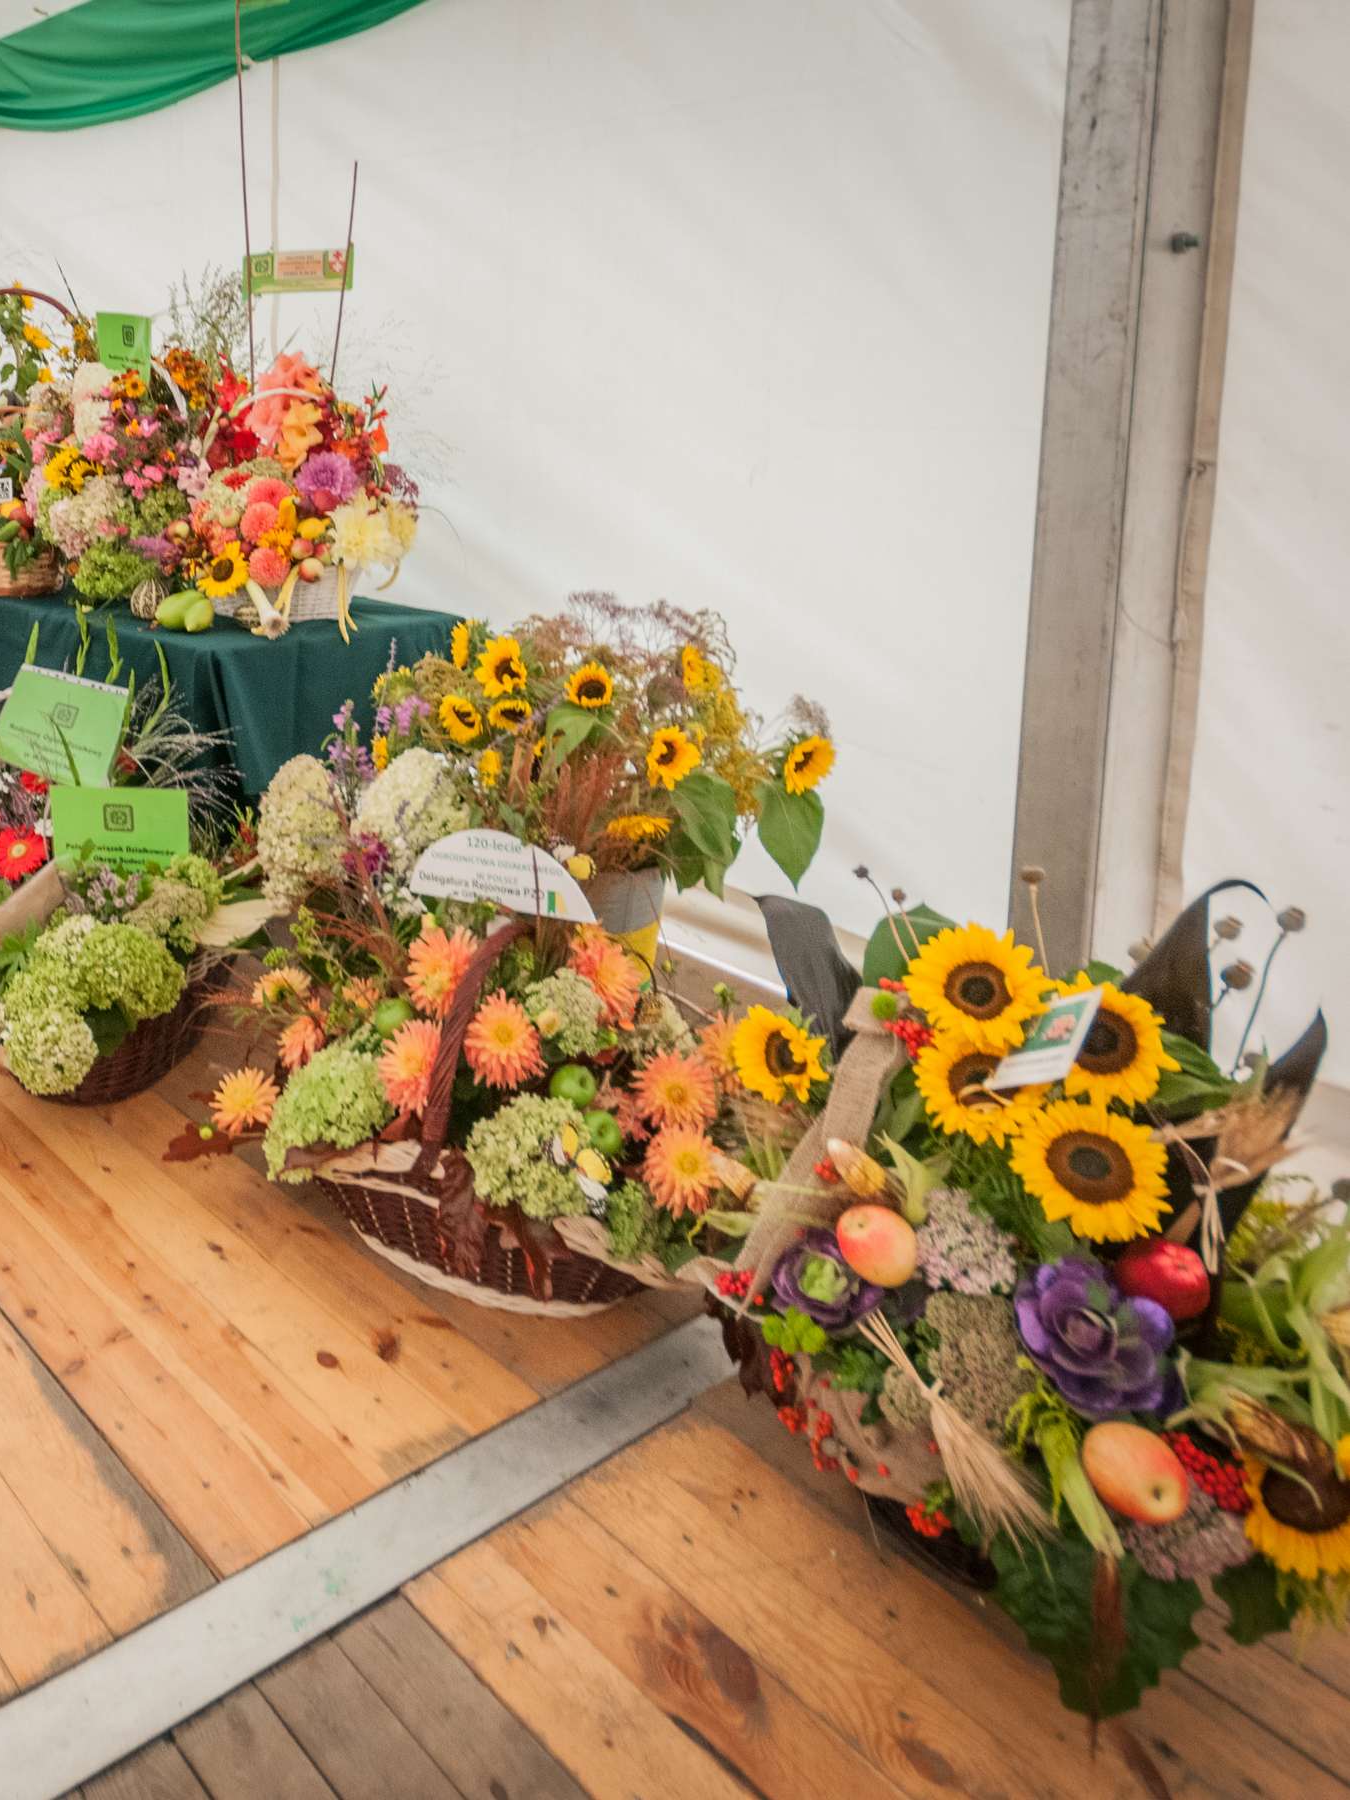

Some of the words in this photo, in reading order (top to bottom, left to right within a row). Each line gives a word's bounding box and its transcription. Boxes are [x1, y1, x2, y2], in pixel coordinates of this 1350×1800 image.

[466, 836, 523, 854] 120-lecie
[419, 871, 469, 888] Delegatura
[472, 880, 521, 897] Rejonowa
